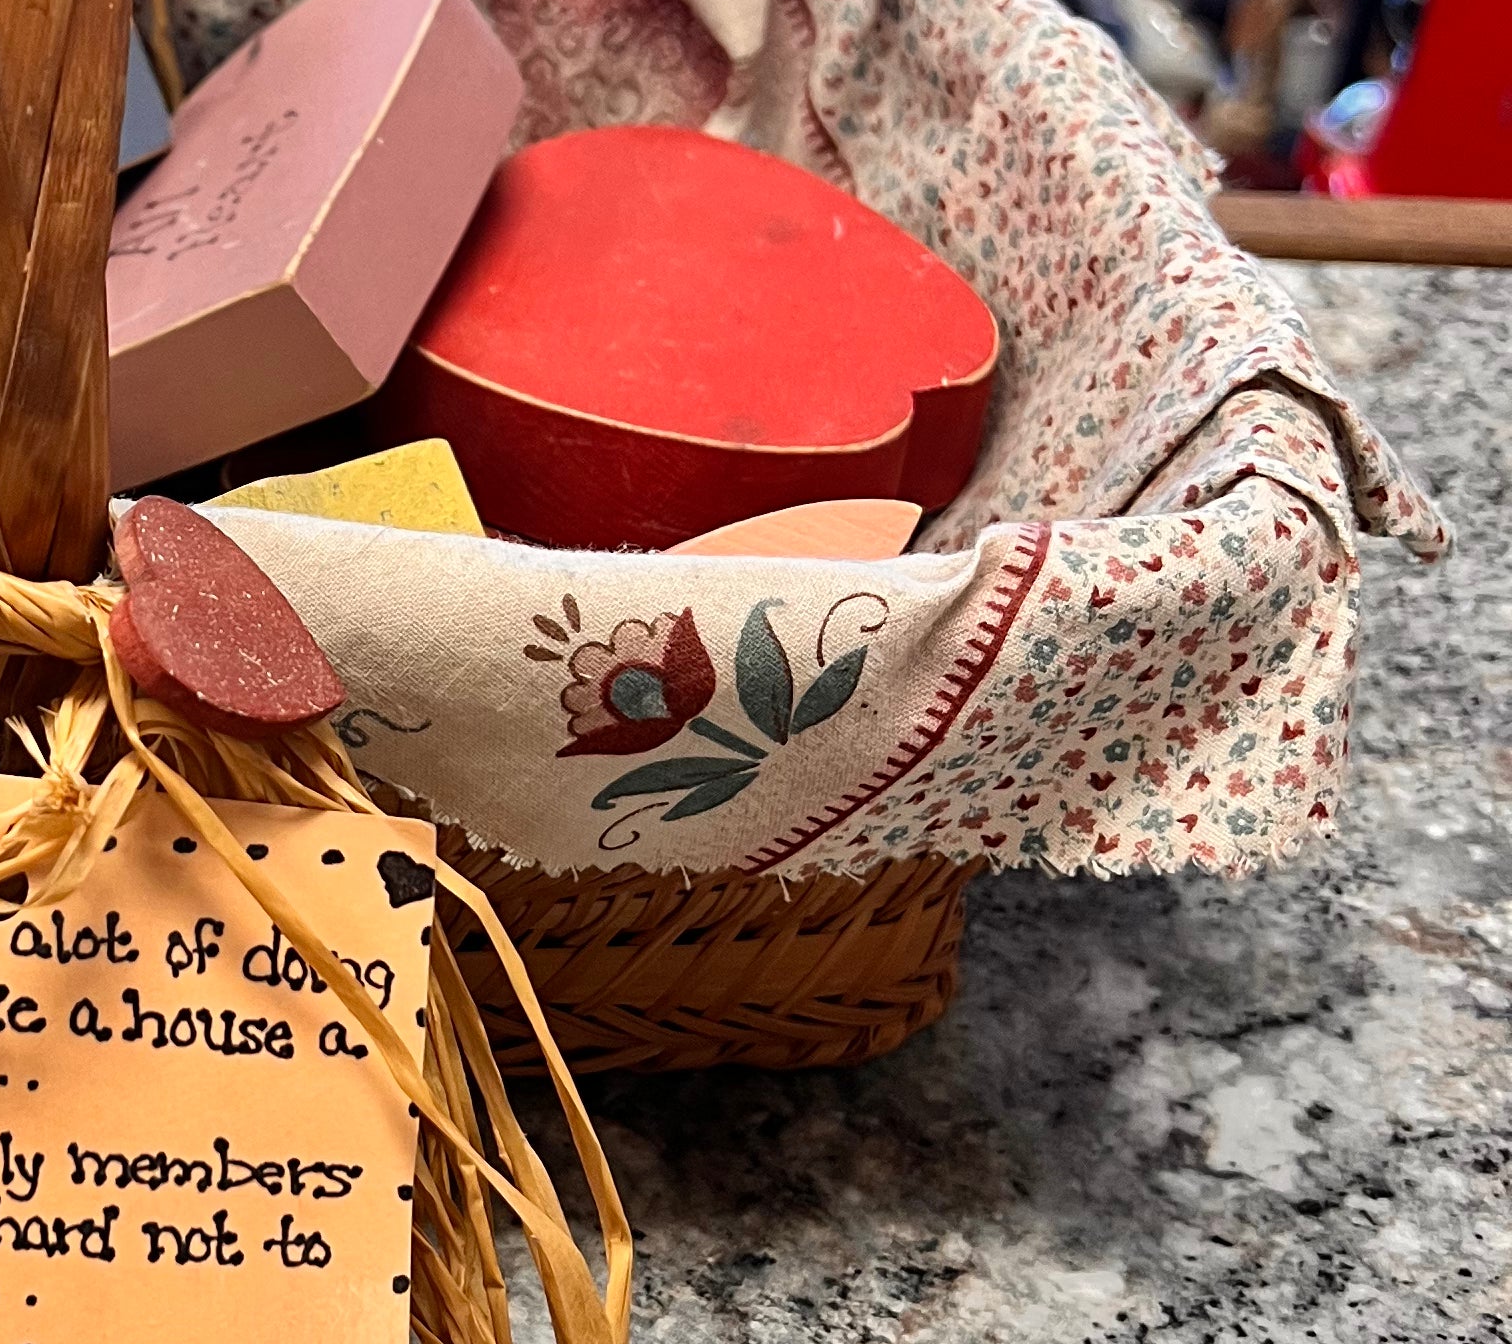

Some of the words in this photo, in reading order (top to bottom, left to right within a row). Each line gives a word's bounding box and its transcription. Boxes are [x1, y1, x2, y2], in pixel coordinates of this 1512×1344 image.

[165, 917, 224, 976] of
[67, 1138, 363, 1199] members
[140, 1210, 244, 1268] not
[263, 1214, 331, 1270] to
